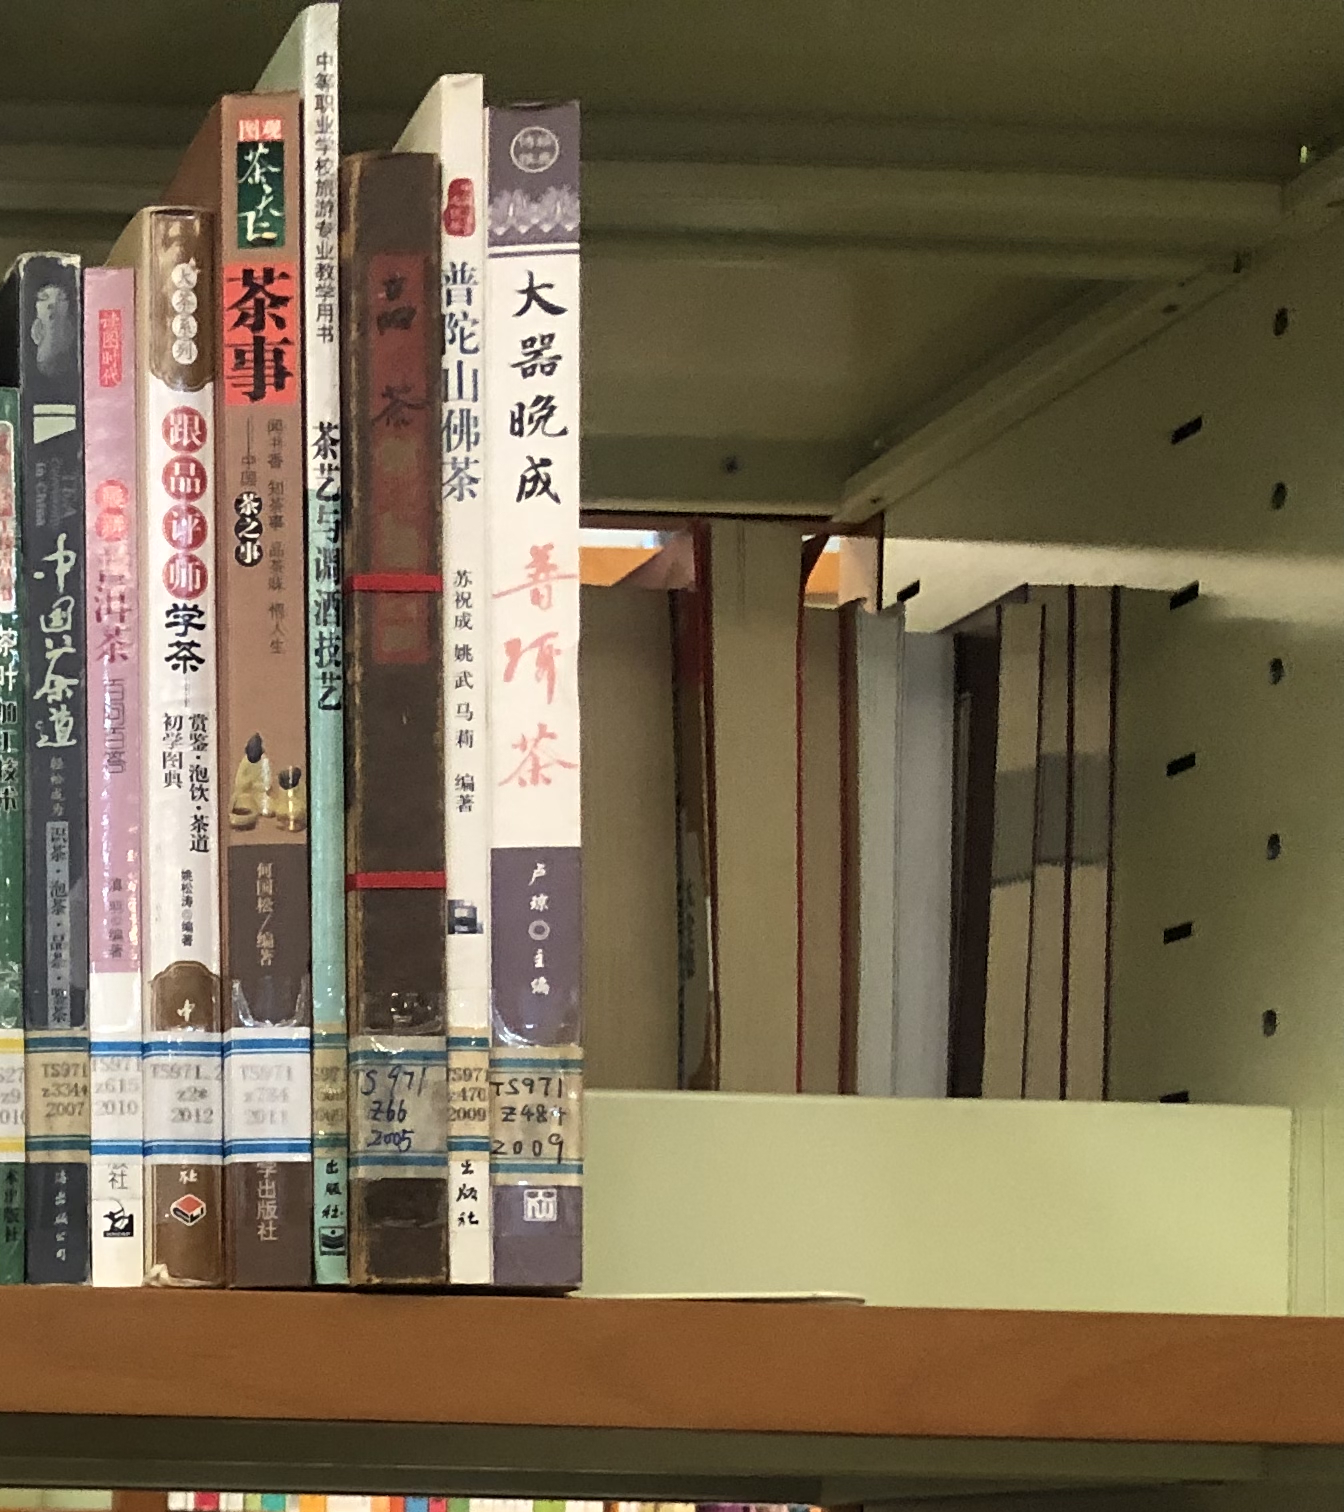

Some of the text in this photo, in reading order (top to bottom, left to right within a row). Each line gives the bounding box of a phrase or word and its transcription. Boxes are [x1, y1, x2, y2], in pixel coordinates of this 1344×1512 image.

[228, 268, 293, 402] 茶事
[442, 260, 481, 502] 普陀山佛茶
[509, 270, 568, 505] 大器晚成
[311, 421, 343, 712] 茶艺与调酒技艺
[161, 712, 185, 788] 初学图典
